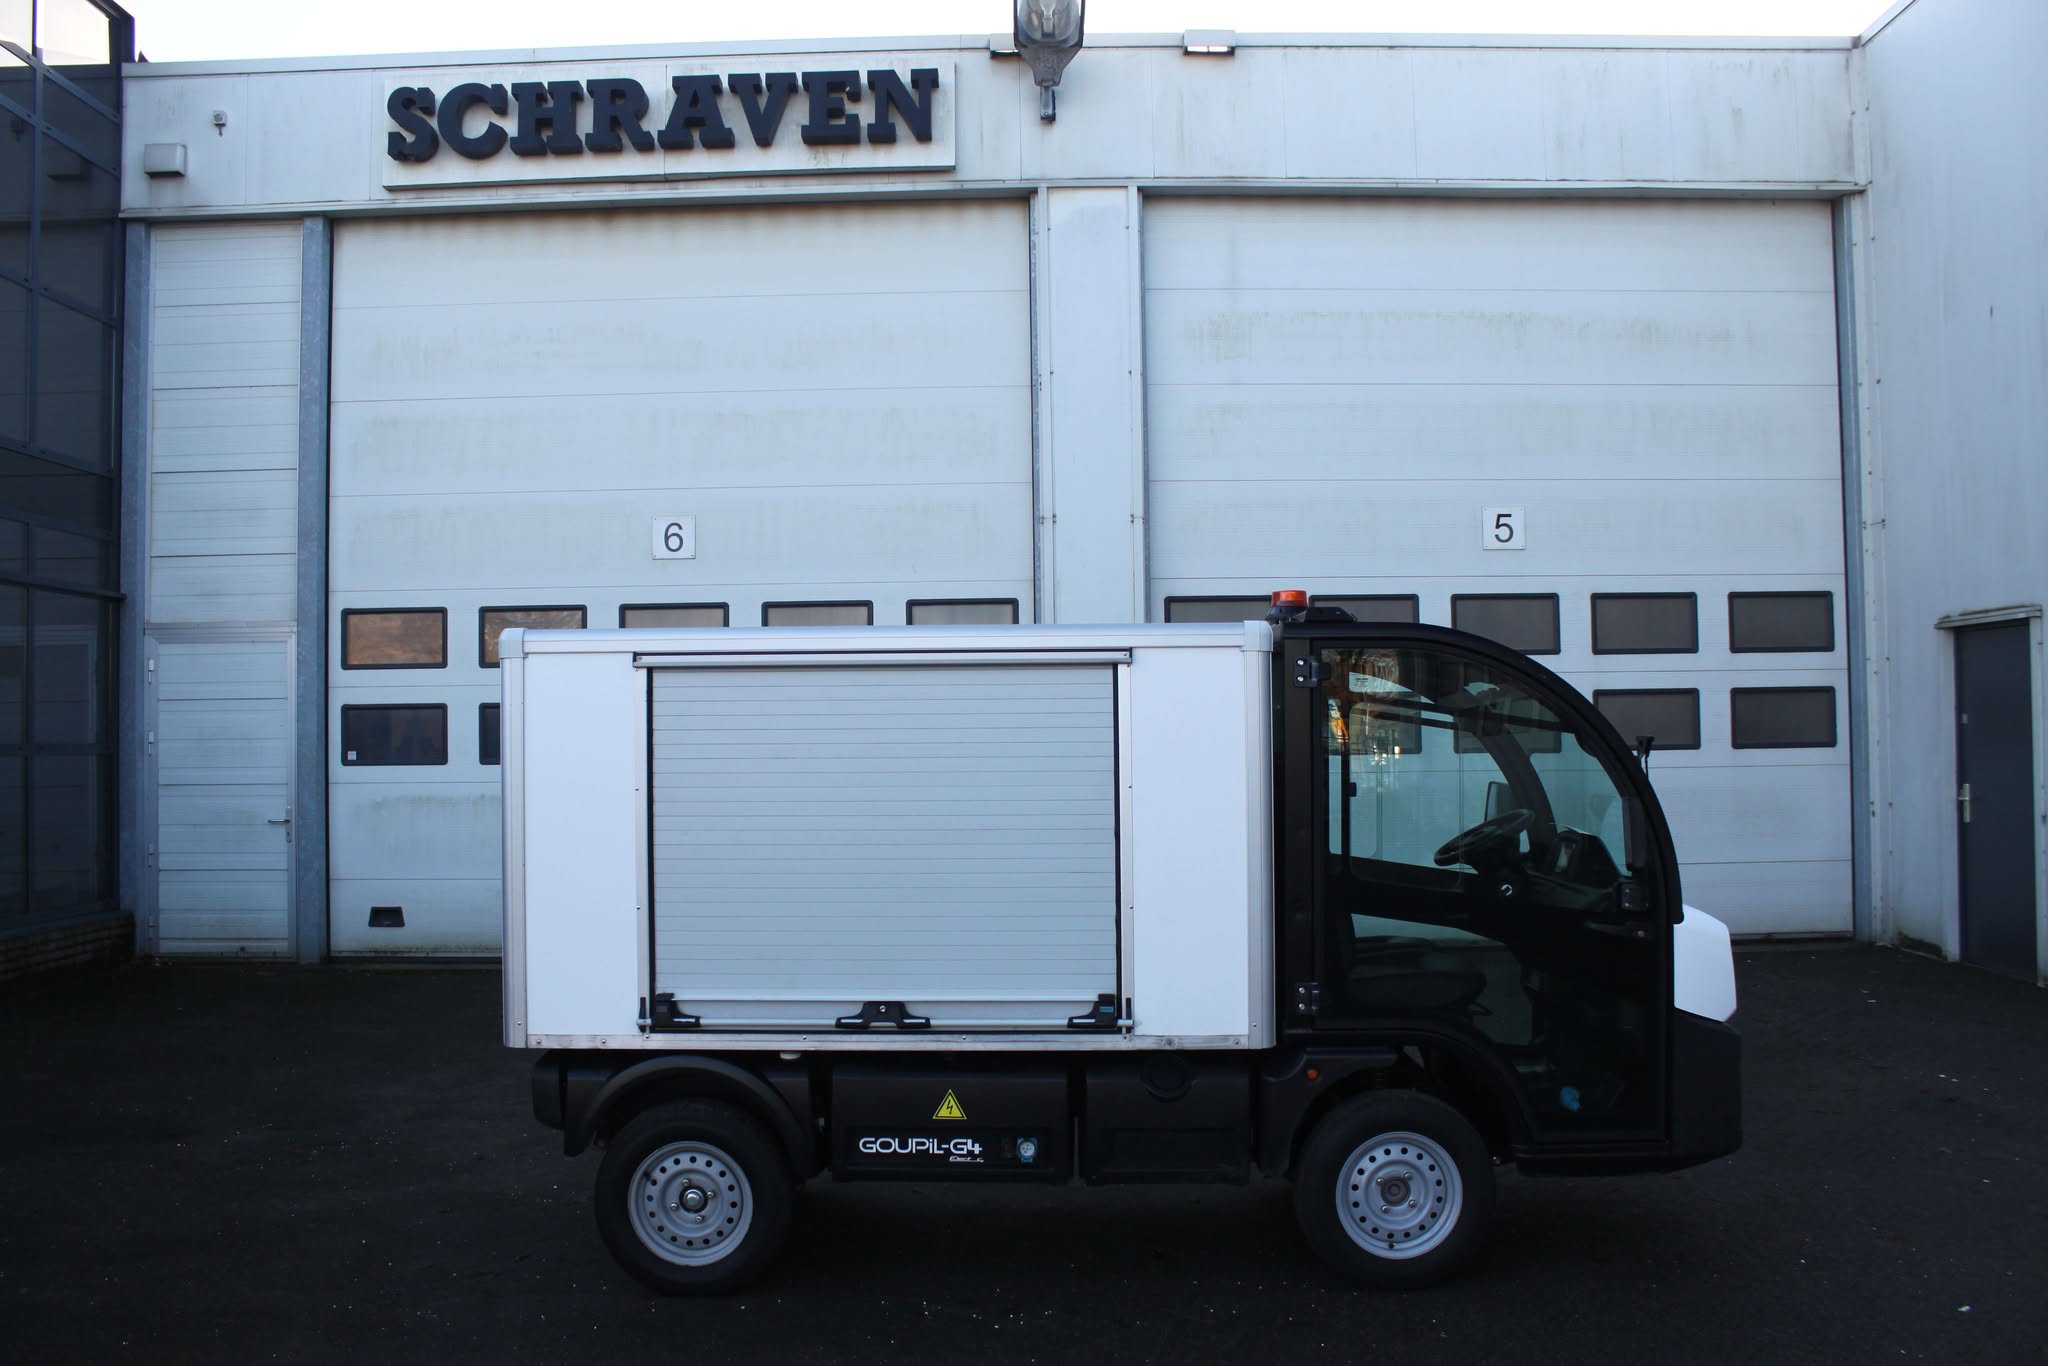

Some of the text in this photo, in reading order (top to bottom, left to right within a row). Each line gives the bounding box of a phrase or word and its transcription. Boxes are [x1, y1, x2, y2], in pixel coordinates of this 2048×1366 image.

[387, 68, 939, 162] SCHRAVEN
[664, 522, 683, 552] 6
[1494, 513, 1514, 543] 5
